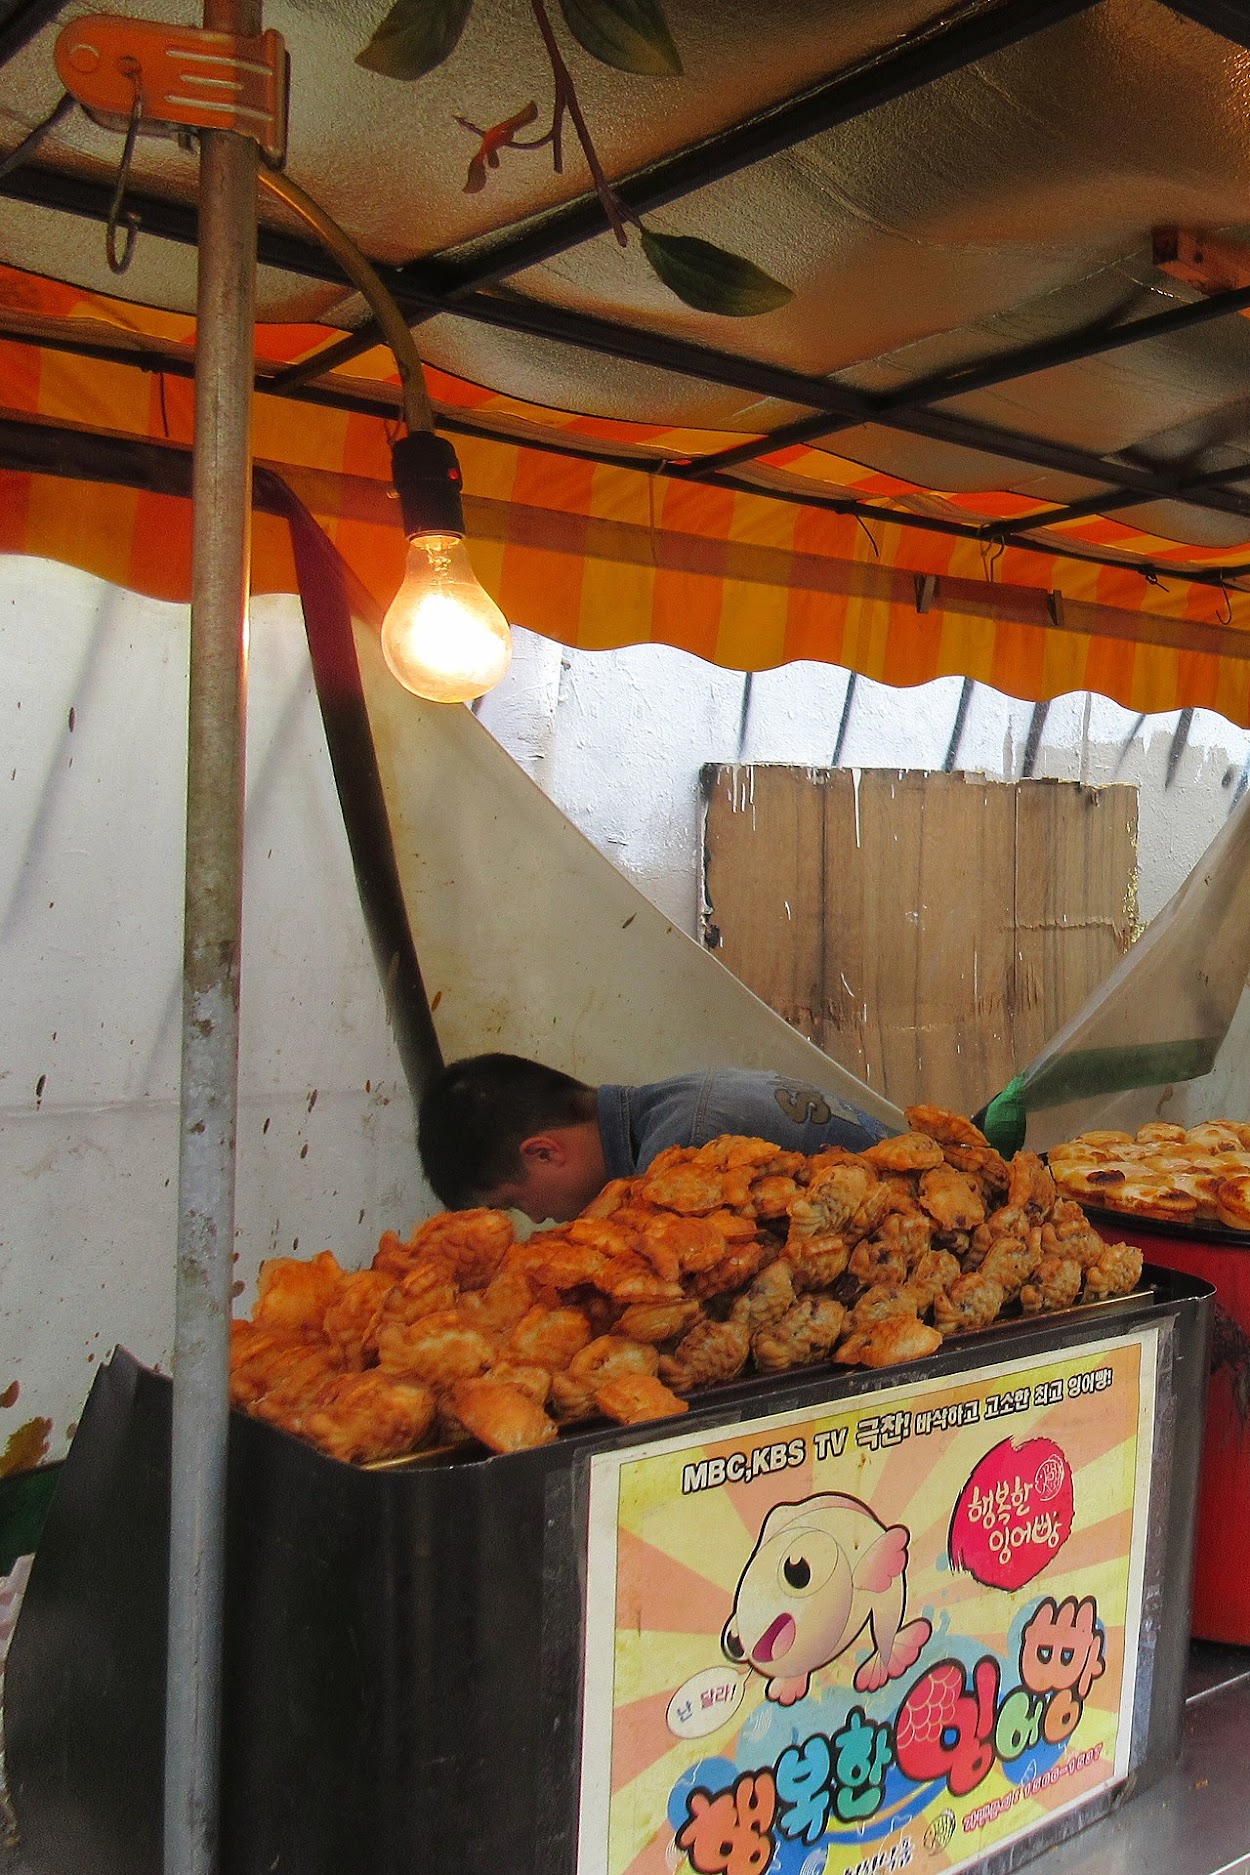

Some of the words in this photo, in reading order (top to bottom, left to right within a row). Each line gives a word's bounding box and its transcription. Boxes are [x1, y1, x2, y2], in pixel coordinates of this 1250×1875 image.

[682, 1437, 806, 1495] MBC,KBS
[813, 1426, 849, 1460] TV
[856, 1410, 911, 1451] 극찬!
[914, 1399, 980, 1436] 바삭하고
[983, 1386, 1031, 1420] 고소한
[1033, 1378, 1064, 1407] 최고
[1066, 1366, 1114, 1398] 잉어빵!
[967, 1475, 1034, 1530] 행복한
[988, 1510, 1063, 1565] 잉어빵
[676, 1700, 694, 1724] 난
[699, 1682, 737, 1711] 달라!
[674, 1705, 894, 1875] 행복한
[893, 1595, 1107, 1797] 잉어빵
